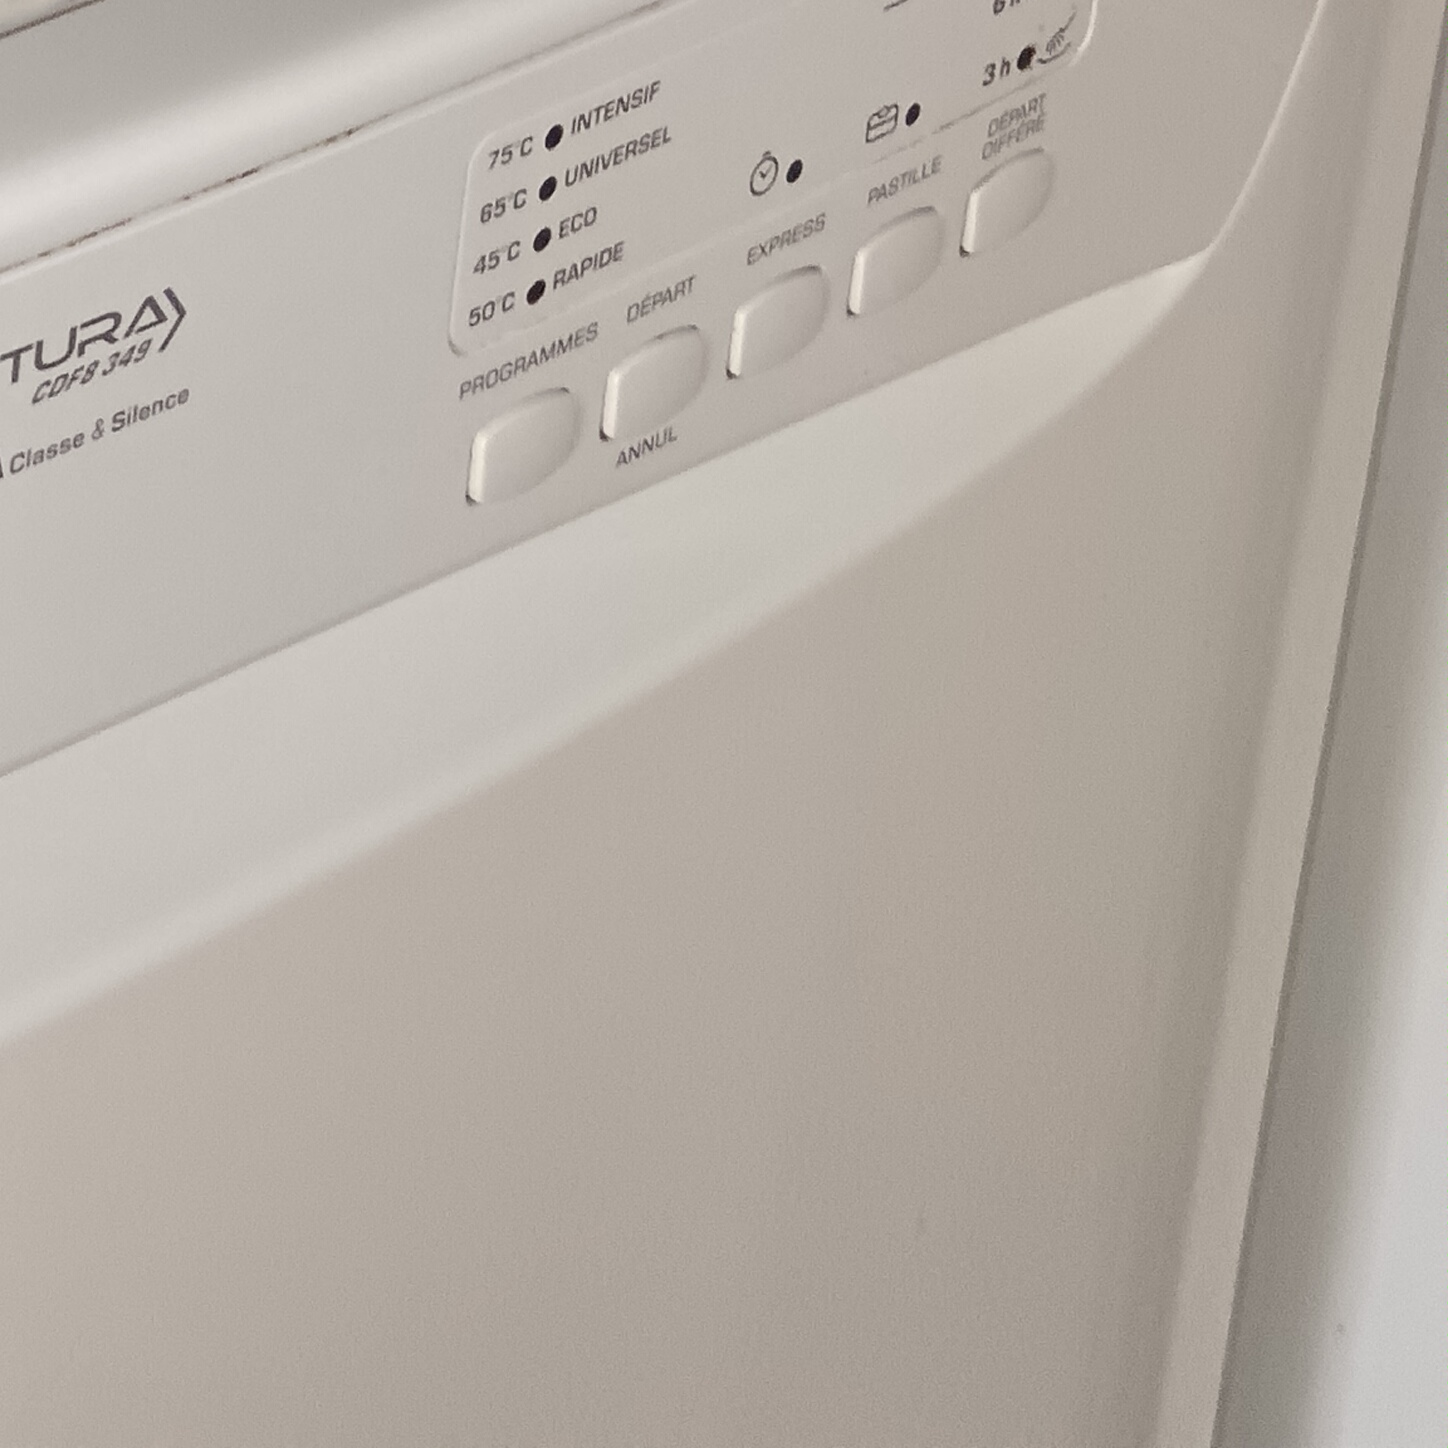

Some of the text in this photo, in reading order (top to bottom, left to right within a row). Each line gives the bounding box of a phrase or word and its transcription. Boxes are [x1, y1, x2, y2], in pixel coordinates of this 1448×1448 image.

[570, 80, 661, 135] INTENSIF
[564, 126, 672, 187] UNIVERSEL
[867, 155, 943, 206] PASTILLE
[558, 206, 598, 239] ECO
[747, 212, 826, 265] EXPRESS
[552, 240, 625, 291] RAPIDE
[626, 274, 696, 324] DÉPART
[101, 338, 153, 376] 349
[459, 321, 599, 400] PROGRAMMES
[9, 431, 85, 474] Classe
[91, 418, 105, 441] &
[111, 387, 190, 433] Silence
[615, 425, 678, 468] ANNUL
